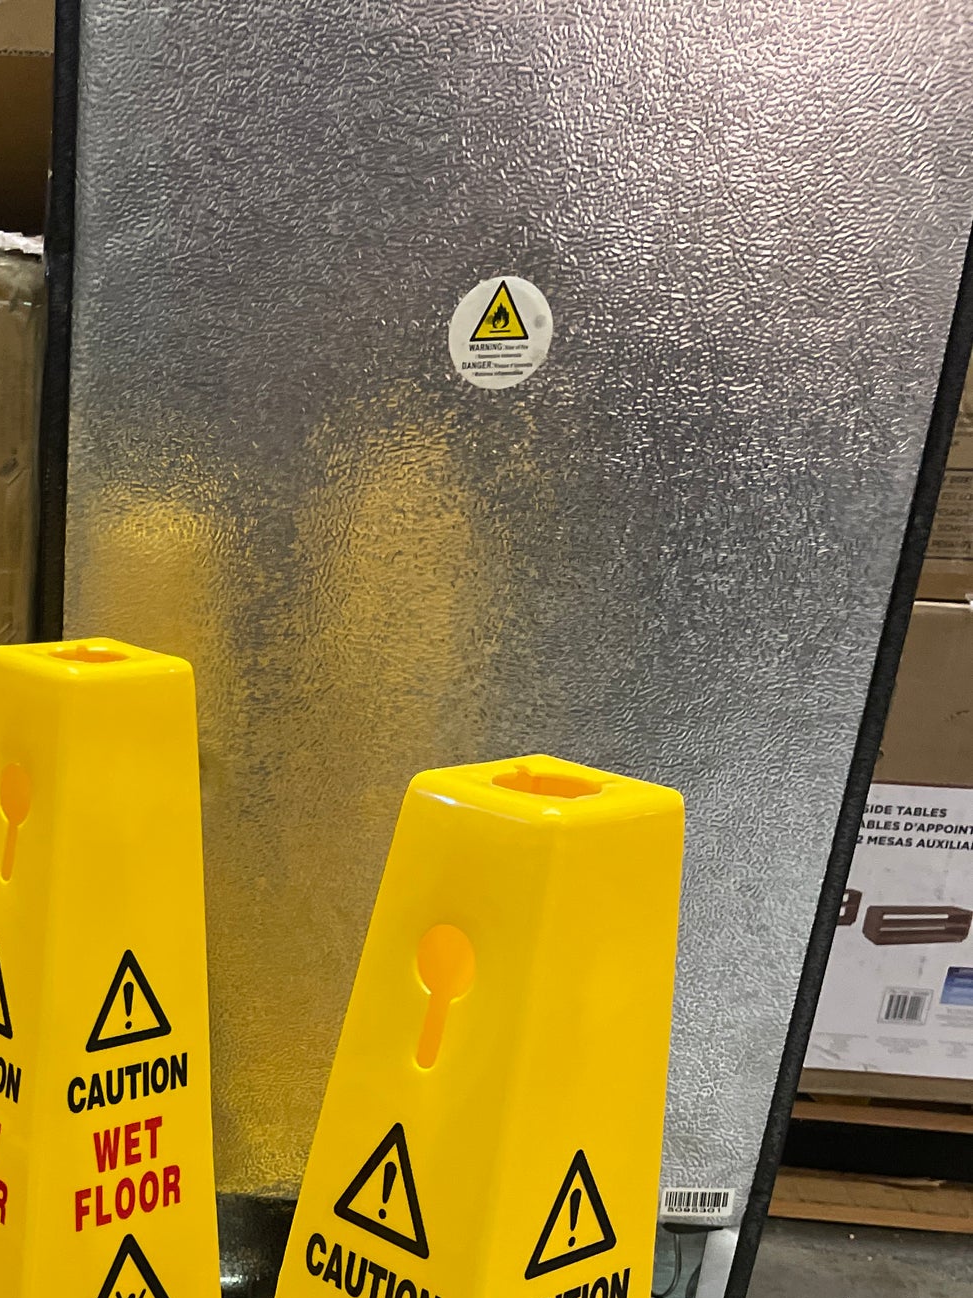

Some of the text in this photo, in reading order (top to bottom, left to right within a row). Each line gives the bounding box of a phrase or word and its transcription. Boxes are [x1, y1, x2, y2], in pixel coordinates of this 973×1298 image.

[897, 806, 947, 818] TABLES
[904, 822, 973, 834] D'APPOINT
[867, 836, 913, 847] MESAS
[916, 839, 973, 850] AUXILIA
[67, 1052, 188, 1113] CAUTION
[93, 1116, 163, 1172] WET
[75, 1165, 181, 1232] FLOOR
